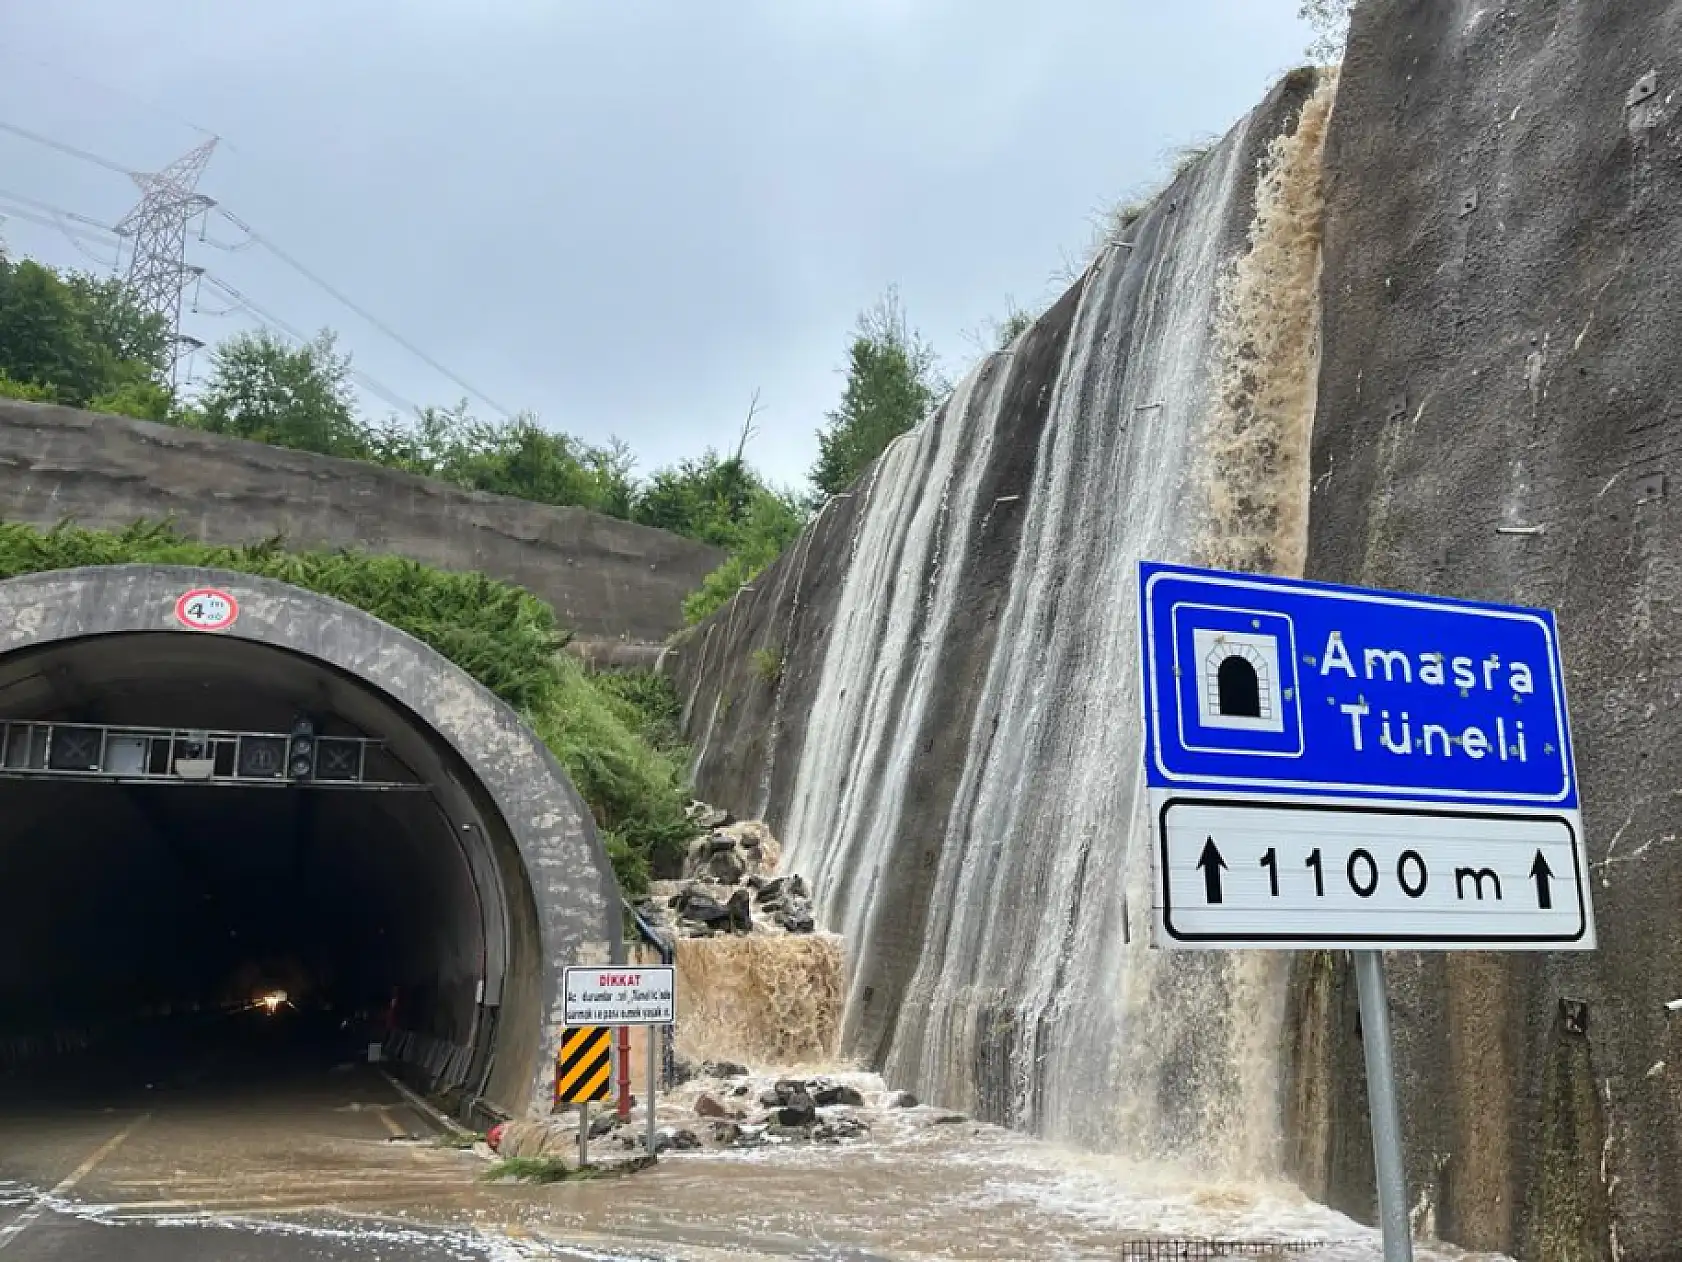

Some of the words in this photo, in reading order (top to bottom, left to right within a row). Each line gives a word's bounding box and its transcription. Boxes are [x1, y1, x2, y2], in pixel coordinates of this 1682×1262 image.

[187, 603, 205, 618] 4
[1340, 703, 1527, 763] Tüneli
[1259, 847, 1429, 898] 1100
[1455, 866, 1503, 899] m
[599, 974, 641, 986] DİKKAT
